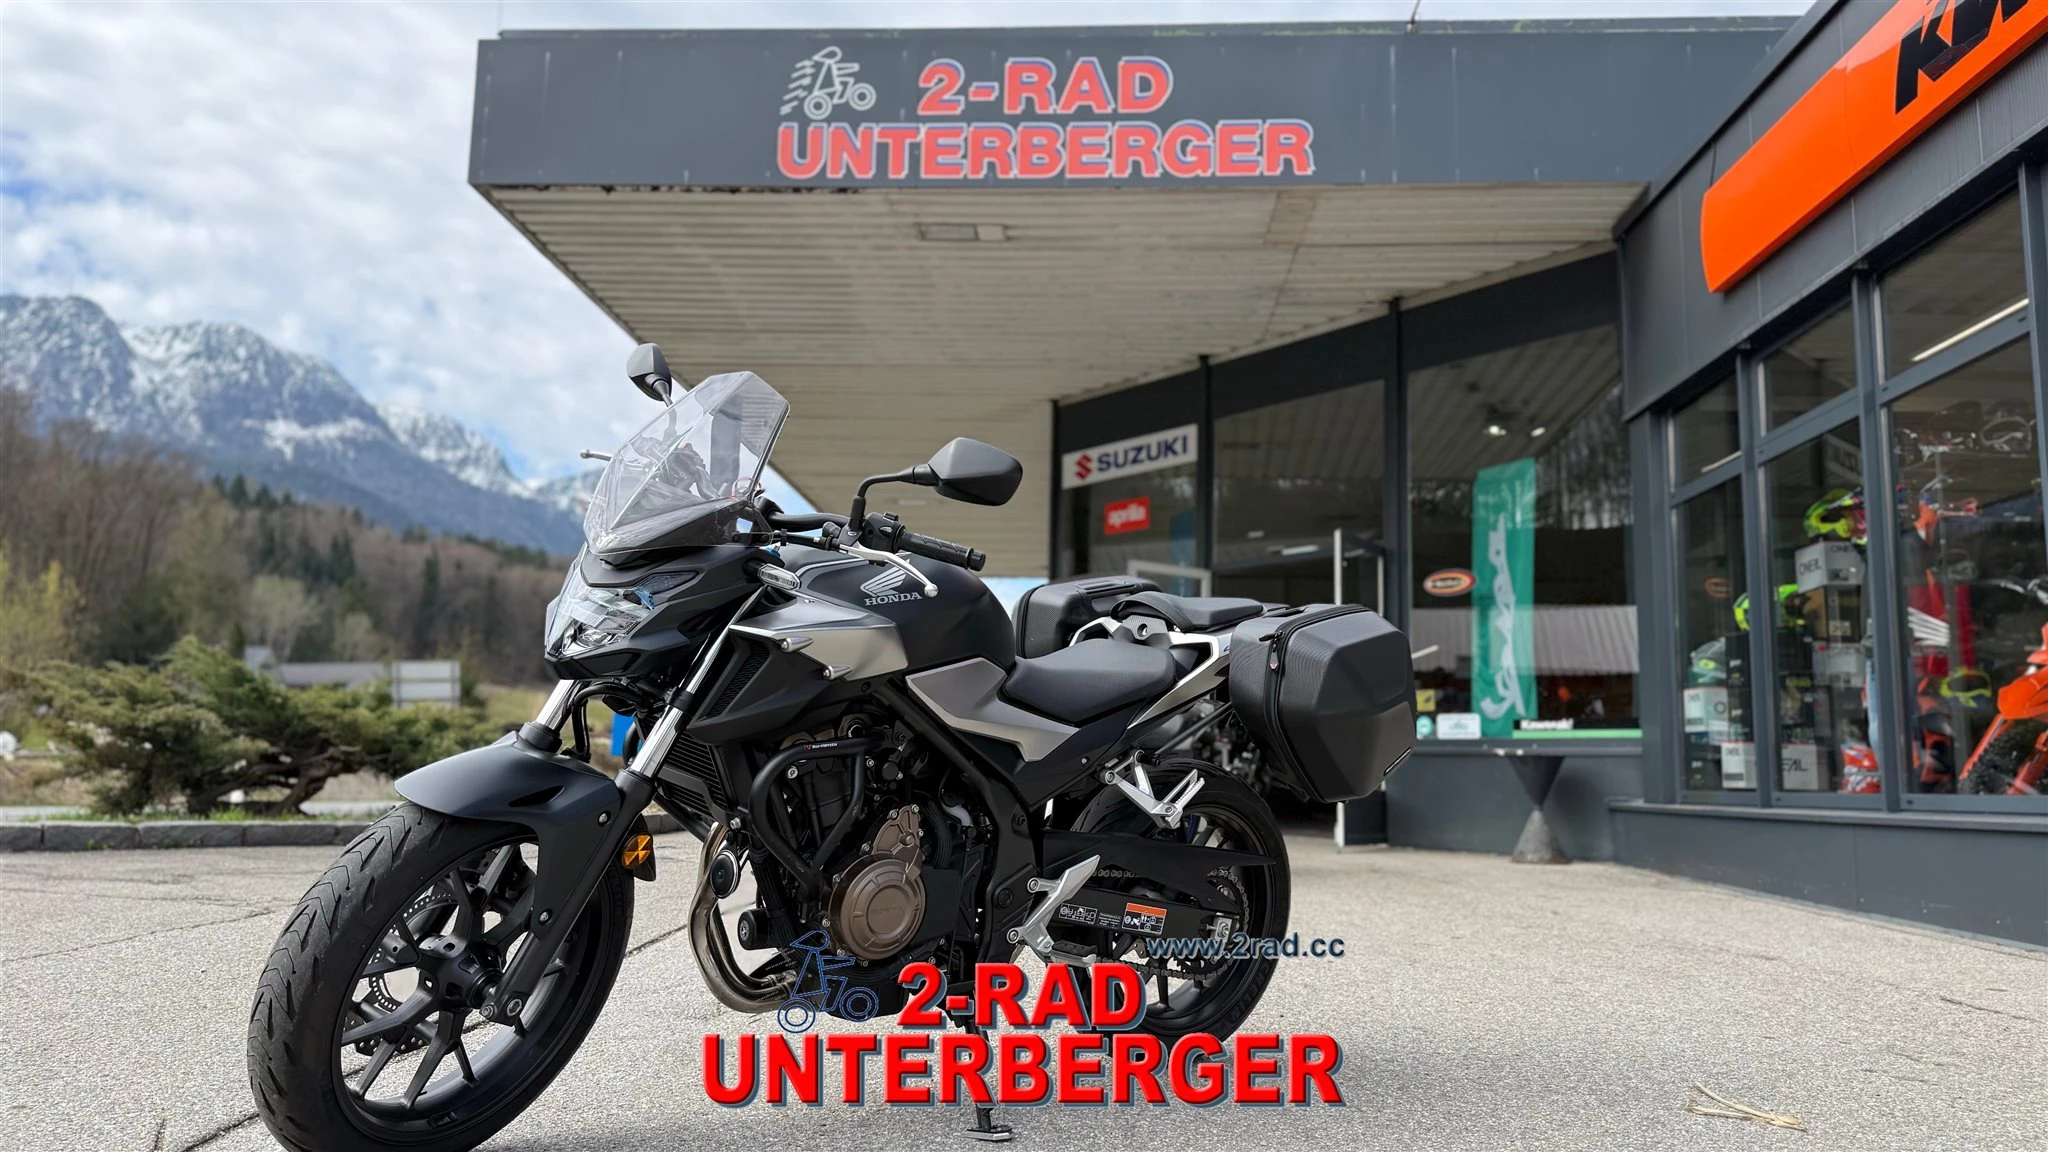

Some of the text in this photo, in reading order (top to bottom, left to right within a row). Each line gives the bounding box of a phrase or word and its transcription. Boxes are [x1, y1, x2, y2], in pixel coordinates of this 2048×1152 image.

[916, 56, 1174, 116] 2-RAD
[776, 119, 1315, 179] UNTERBERGER
[1097, 434, 1188, 472] SUZUKI
[864, 592, 923, 606] HONDA
